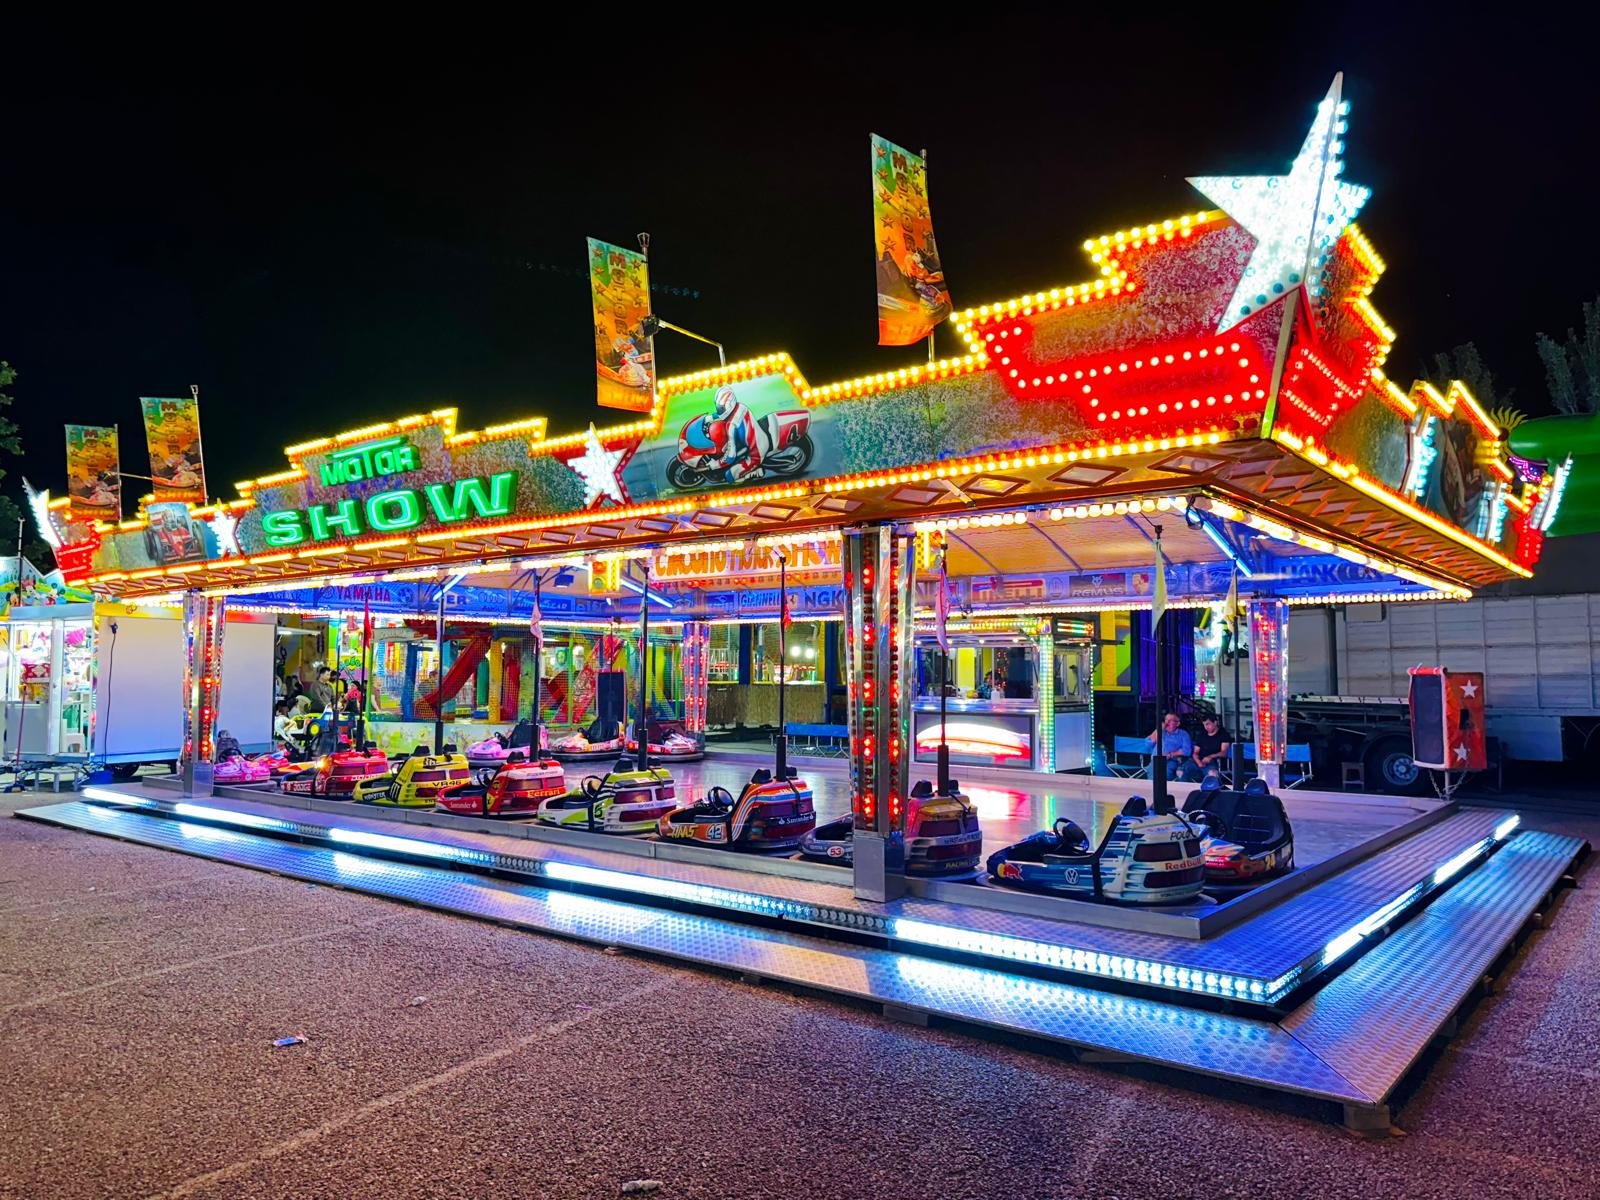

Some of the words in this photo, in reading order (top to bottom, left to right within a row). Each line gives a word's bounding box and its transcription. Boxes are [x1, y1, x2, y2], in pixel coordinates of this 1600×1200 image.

[319, 437, 422, 487] MOTOR
[262, 470, 518, 546] SHOW
[775, 539, 842, 568] SHOW
[337, 585, 391, 602] YAMAHA
[1072, 587, 1124, 597] REMUS
[432, 780, 462, 788] VR46
[527, 788, 561, 798] Ferrari
[707, 825, 722, 839] 42
